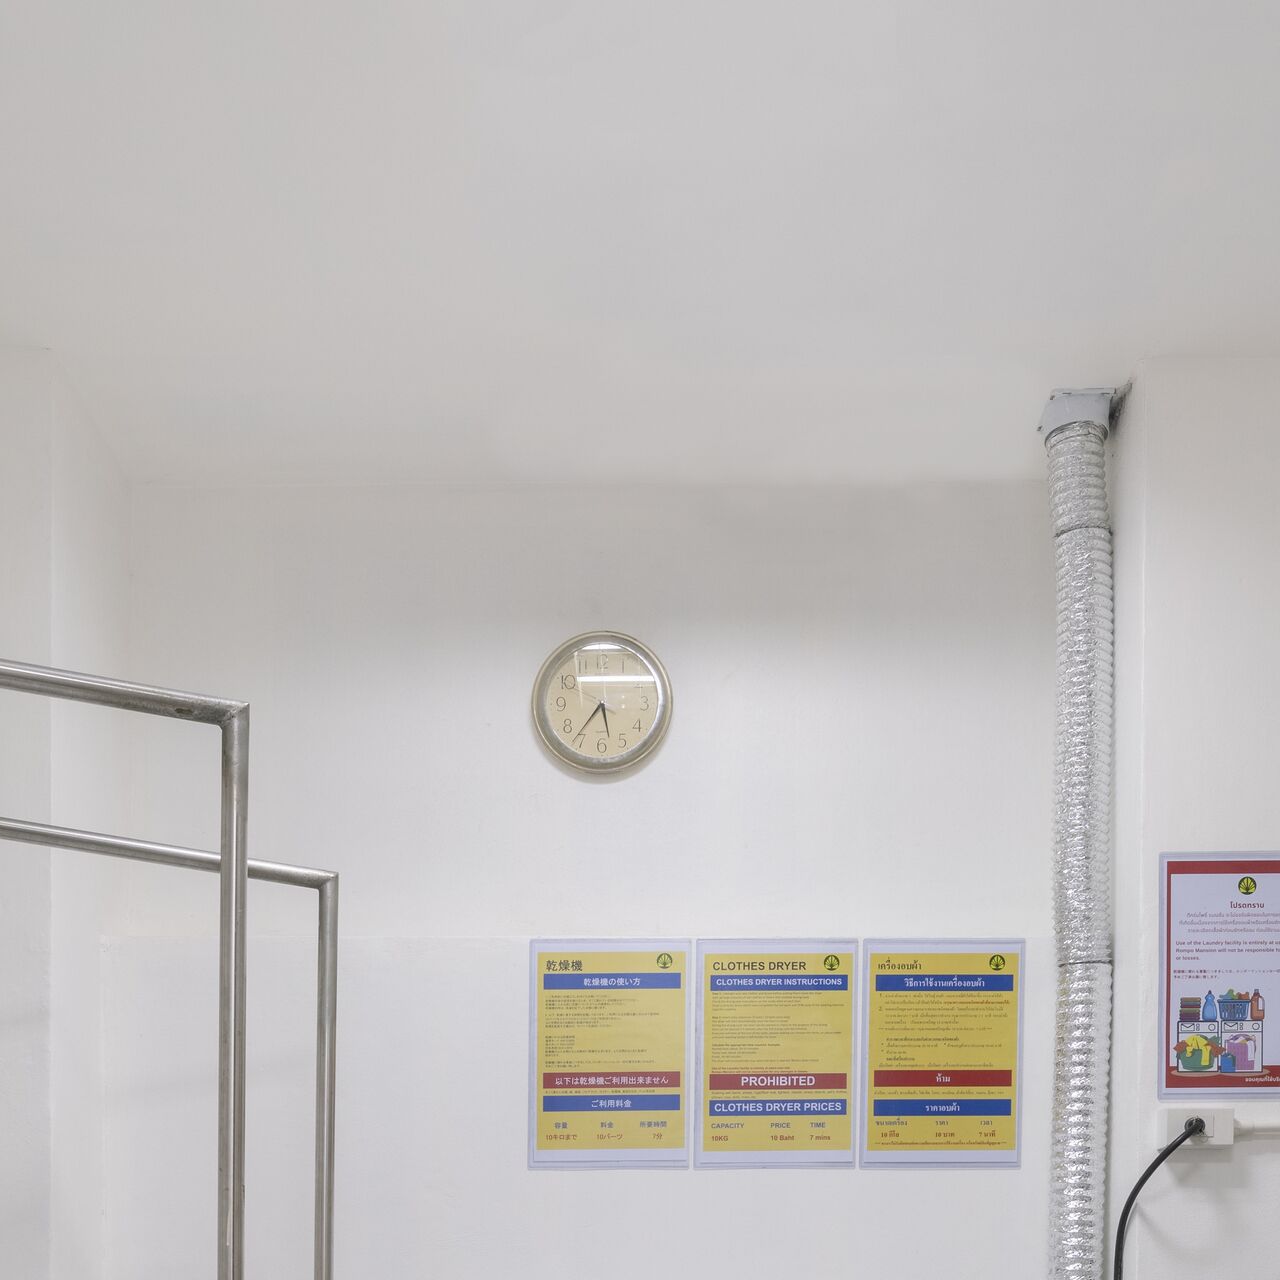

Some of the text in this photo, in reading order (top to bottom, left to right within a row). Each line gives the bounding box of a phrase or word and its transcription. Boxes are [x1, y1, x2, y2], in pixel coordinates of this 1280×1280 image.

[561, 675, 576, 689] 10
[556, 697, 566, 711] 9
[640, 696, 649, 711] 3
[563, 719, 572, 733] 8
[633, 718, 641, 732] 4
[578, 733, 586, 748] 7
[597, 738, 607, 753] 6
[618, 733, 627, 748] 5
[546, 960, 582, 972] 乾燥機
[713, 961, 806, 970] CLOTHES DRYER
[878, 957, 922, 970] เครื่องอบผ้า
[584, 978, 640, 986] 乾燥機の使い方
[904, 976, 985, 988] วิธีการใช้งานเครื่องอบผ้า
[555, 1076, 668, 1085] 以下は乾燥機ご利用出来ません
[741, 1076, 815, 1086] PROHIBITED
[936, 1073, 950, 1082] ห้าม
[591, 1100, 632, 1108] ご利用料金
[714, 1102, 842, 1112] CLOTHES DRYER PRICES
[925, 1102, 960, 1112] ราคาอบผ้า
